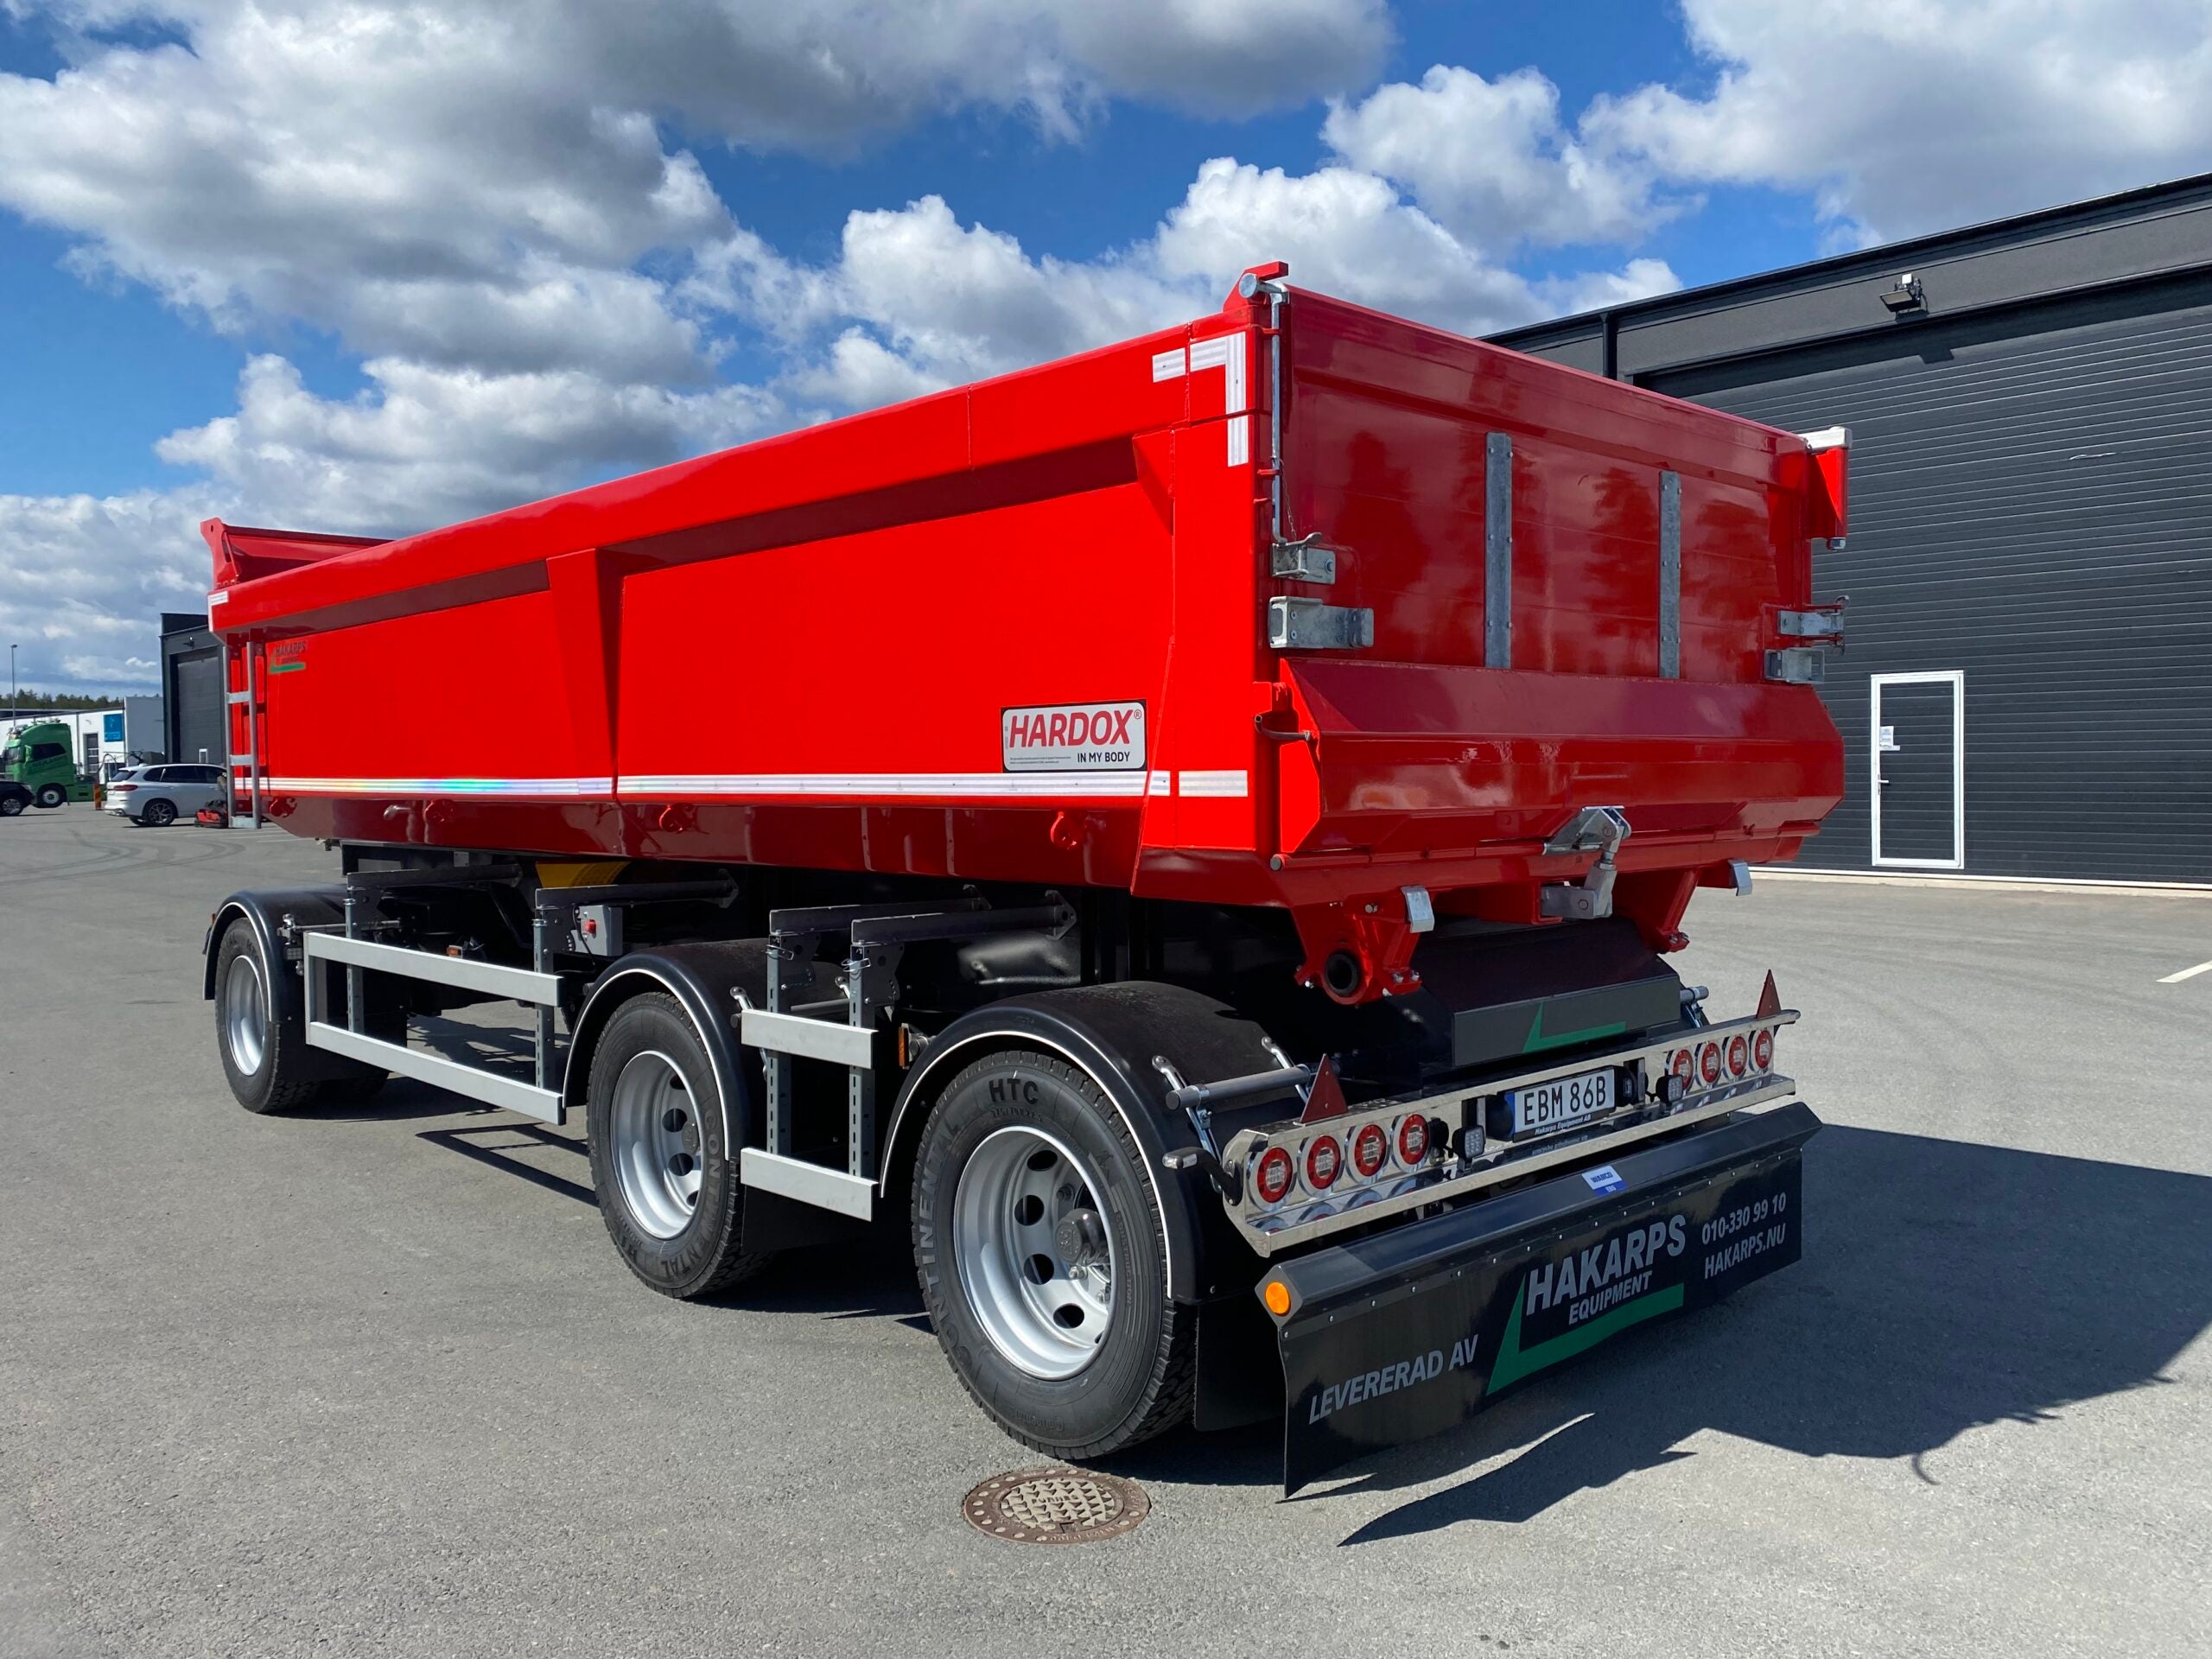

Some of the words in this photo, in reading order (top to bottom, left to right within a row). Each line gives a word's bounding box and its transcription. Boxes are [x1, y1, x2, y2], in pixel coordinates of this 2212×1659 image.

[1077, 753, 1086, 763] IN
[1089, 752, 1102, 762] MY
[1104, 751, 1130, 762] BODY
[988, 1077, 1039, 1105] HTC
[1524, 1085, 1563, 1125] EBM
[1570, 1076, 1606, 1112] 86B
[1590, 1172, 1613, 1183] WABCO
[918, 1115, 973, 1370] CONTINENTAL
[1702, 1206, 1751, 1244] 010-330
[1752, 1199, 1769, 1223] 99
[1772, 1192, 1786, 1215] 10
[1526, 1214, 1686, 1316] HAKARPS
[1705, 1223, 1786, 1280] HAKARPS.NU
[1568, 1270, 1652, 1325] EQUIPMENT
[1309, 1350, 1444, 1424] LEVERERAD
[1448, 1334, 1478, 1371] AV
